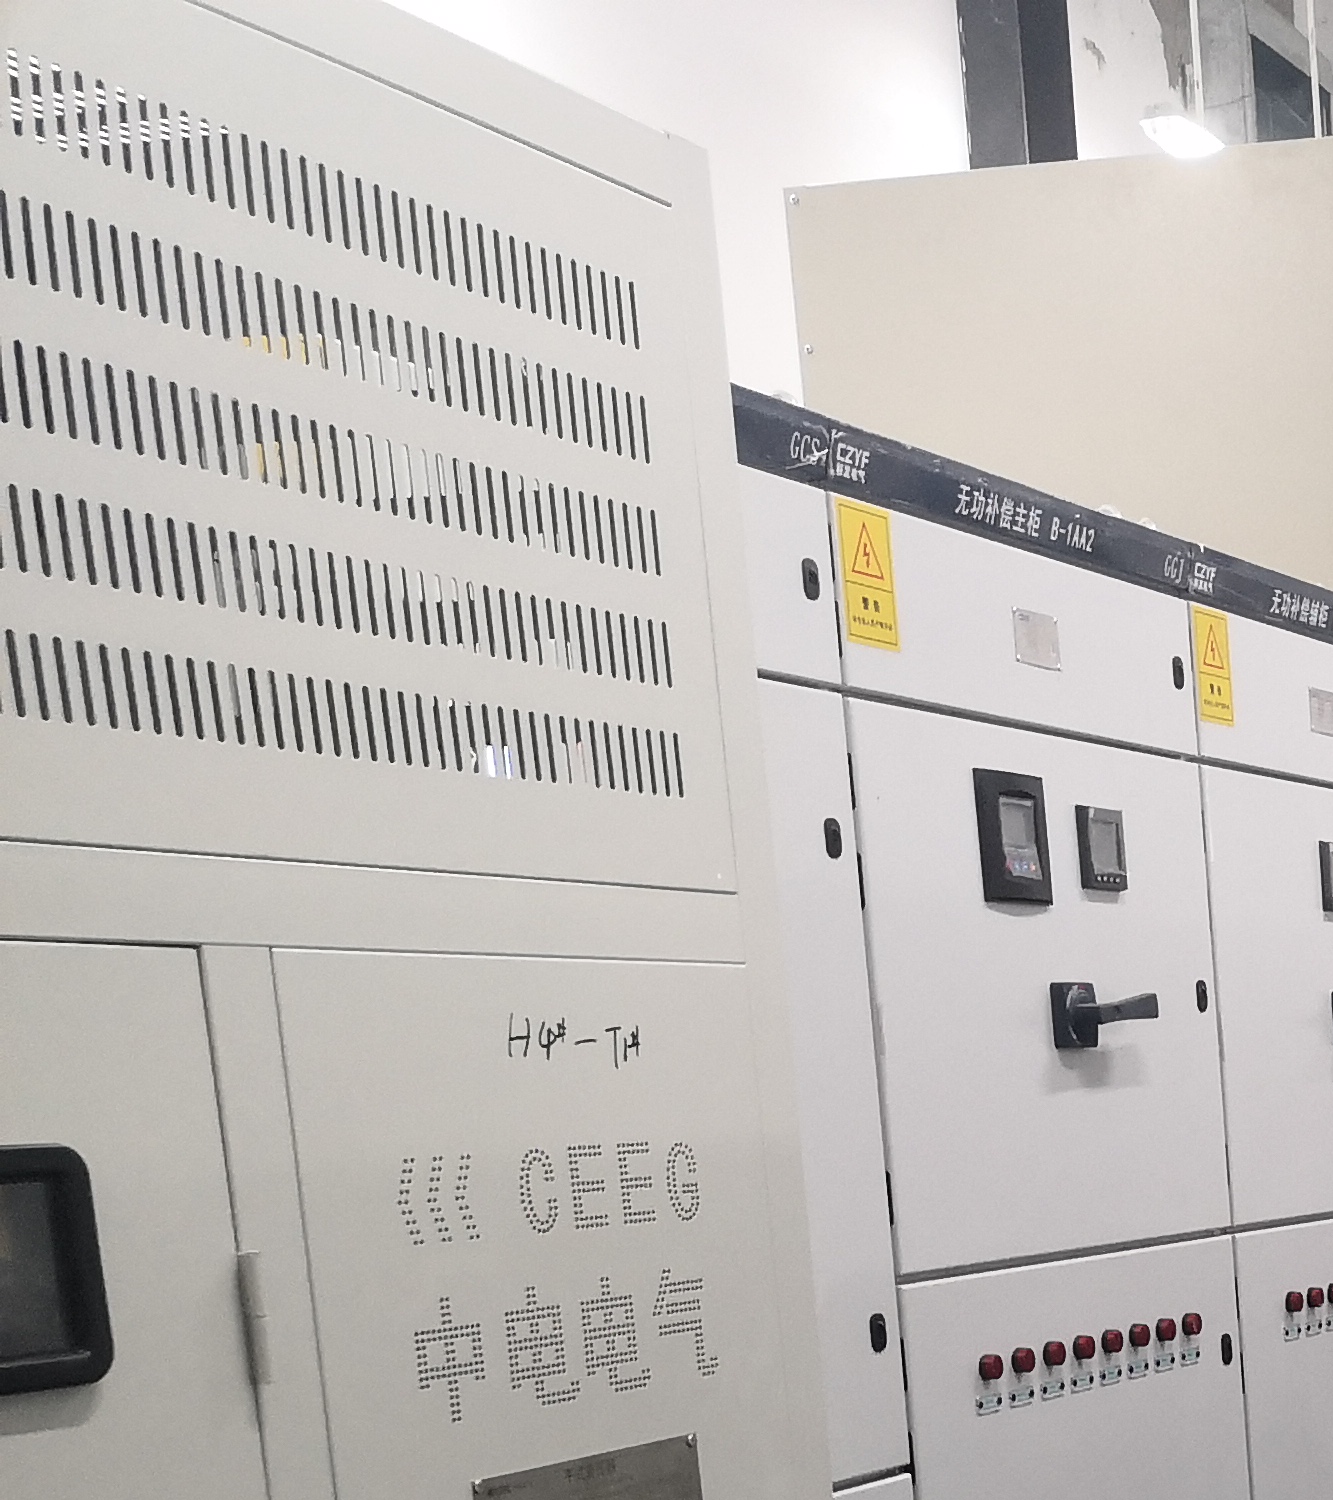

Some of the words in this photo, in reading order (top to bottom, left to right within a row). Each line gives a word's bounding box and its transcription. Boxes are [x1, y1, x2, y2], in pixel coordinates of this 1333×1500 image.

[790, 431, 821, 465] GCS
[836, 442, 871, 469] CZYF
[954, 483, 1043, 539] 无功补偿主柜
[1049, 515, 1096, 553] B-1AA2
[1194, 561, 1218, 583] CZYF
[517, 1140, 702, 1236] CEEG
[411, 1266, 721, 1423] 中电电气
